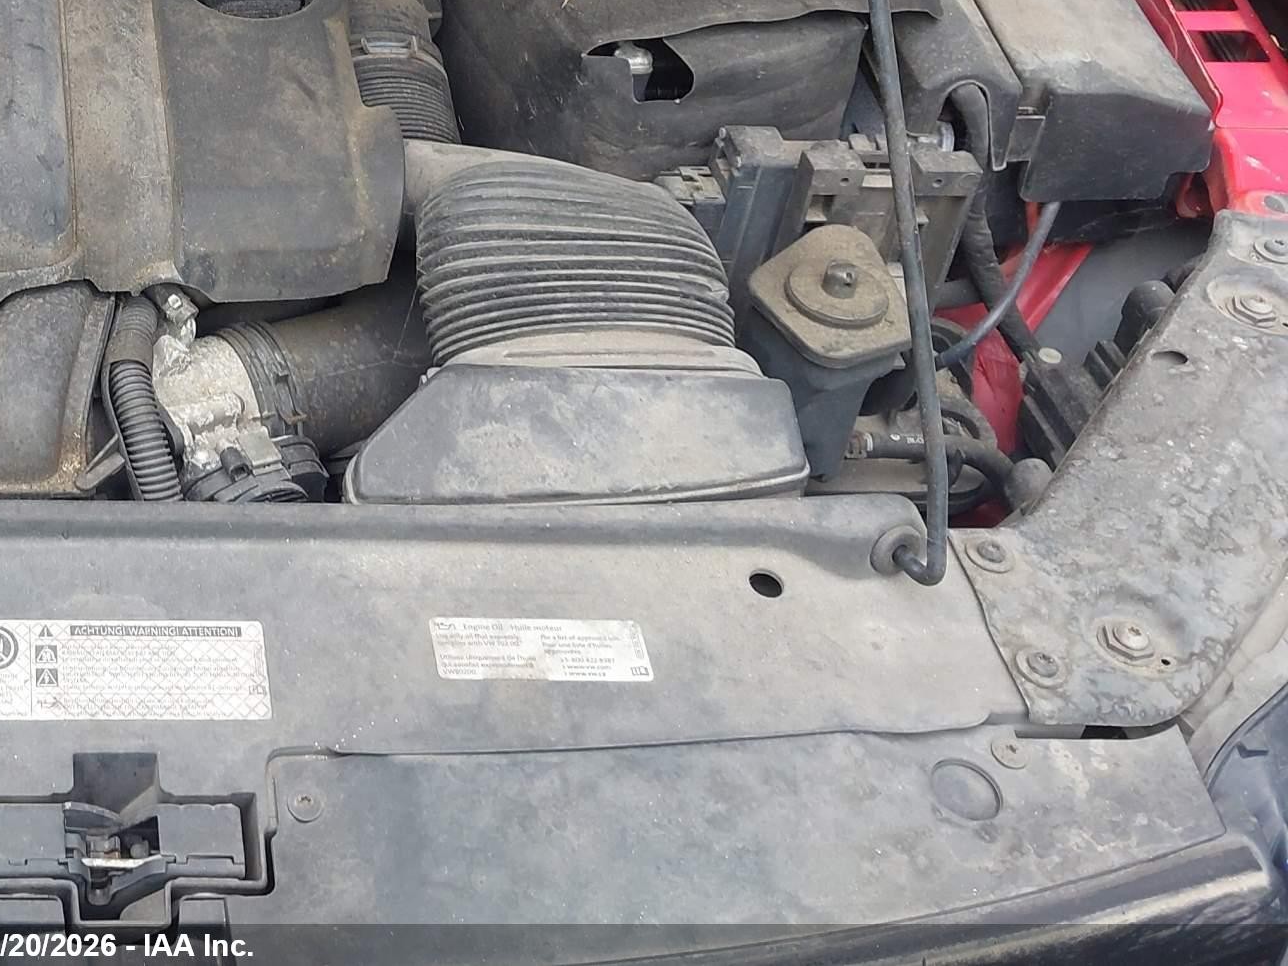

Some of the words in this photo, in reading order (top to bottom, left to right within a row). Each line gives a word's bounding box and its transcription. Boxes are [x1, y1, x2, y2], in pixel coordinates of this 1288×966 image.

[74, 625, 126, 636] ACHTUNG!
[128, 625, 179, 636] WARNING!
[181, 626, 239, 637] ATTENTION!
